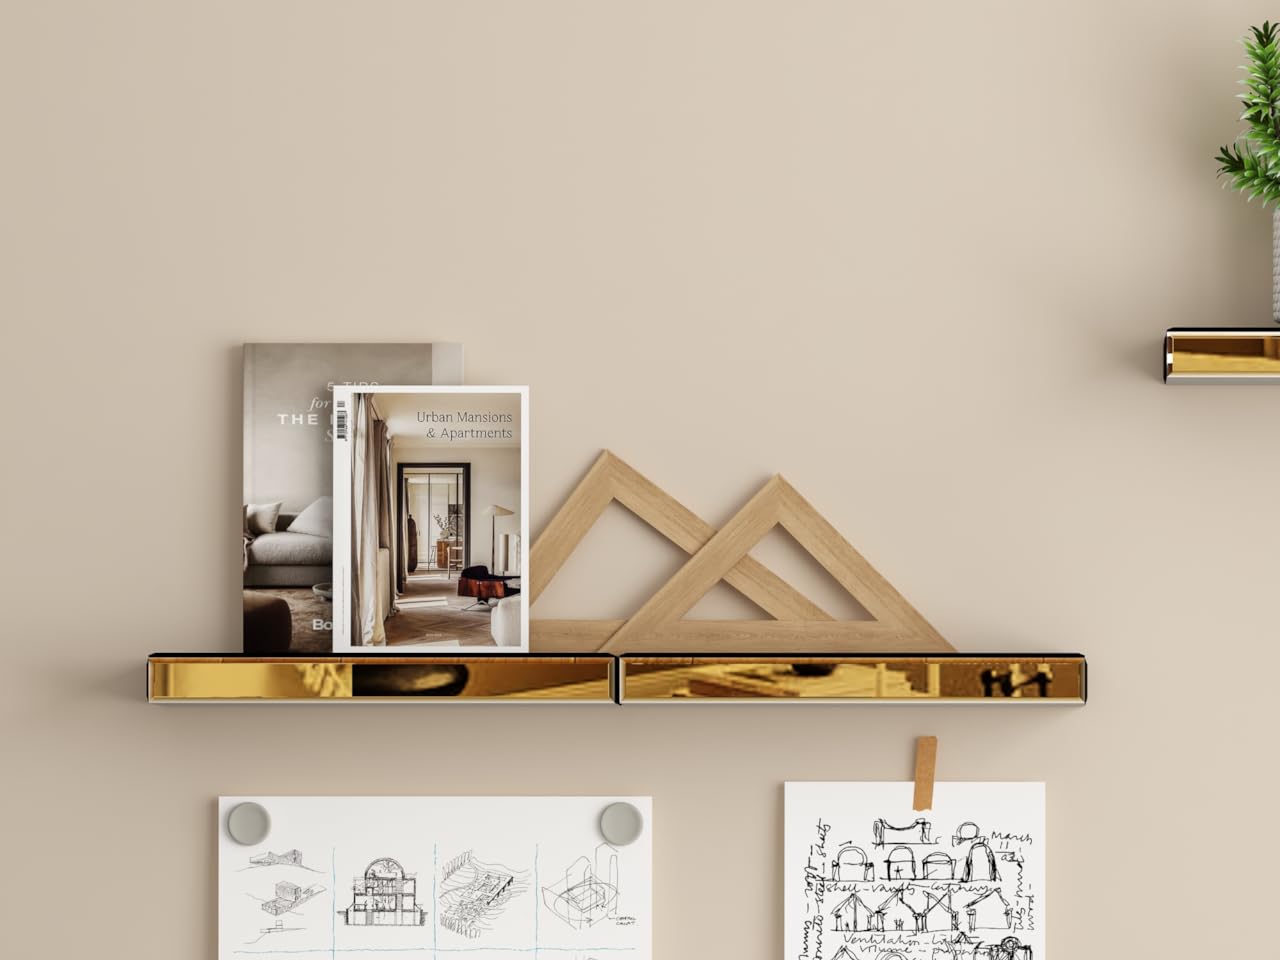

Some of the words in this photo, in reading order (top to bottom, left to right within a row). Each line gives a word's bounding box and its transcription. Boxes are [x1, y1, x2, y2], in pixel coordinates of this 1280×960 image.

[307, 397, 332, 413] for
[277, 414, 319, 425] THE
[417, 411, 453, 423] Urban
[457, 411, 513, 423] Mansions
[426, 428, 436, 438] &
[440, 428, 513, 441] Apartments
